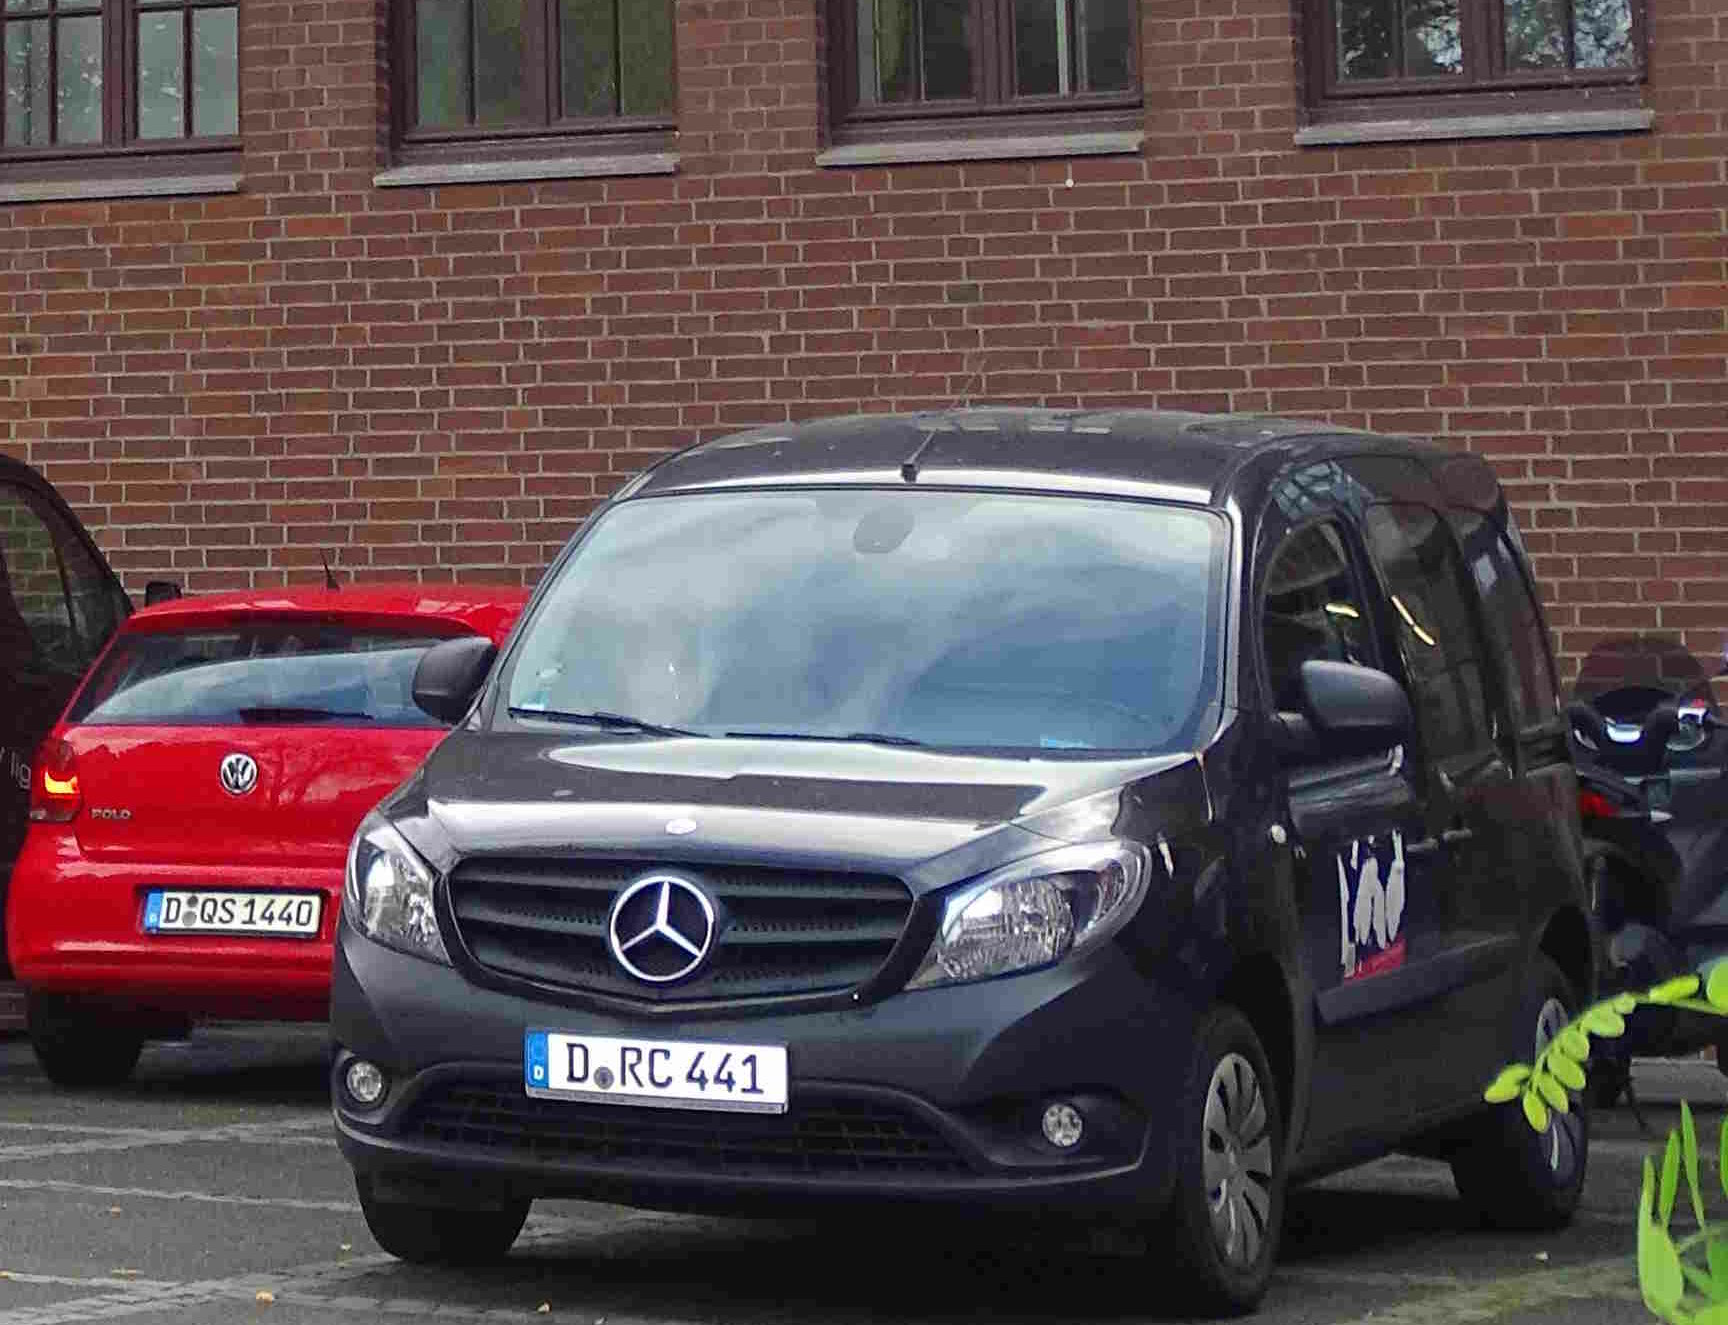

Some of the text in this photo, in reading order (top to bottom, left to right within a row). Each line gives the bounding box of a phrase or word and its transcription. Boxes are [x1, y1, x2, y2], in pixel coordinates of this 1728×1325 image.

[9, 751, 33, 791] lig
[91, 808, 132, 820] POLO
[241, 898, 313, 927] 1440
[686, 1051, 765, 1095] 441
